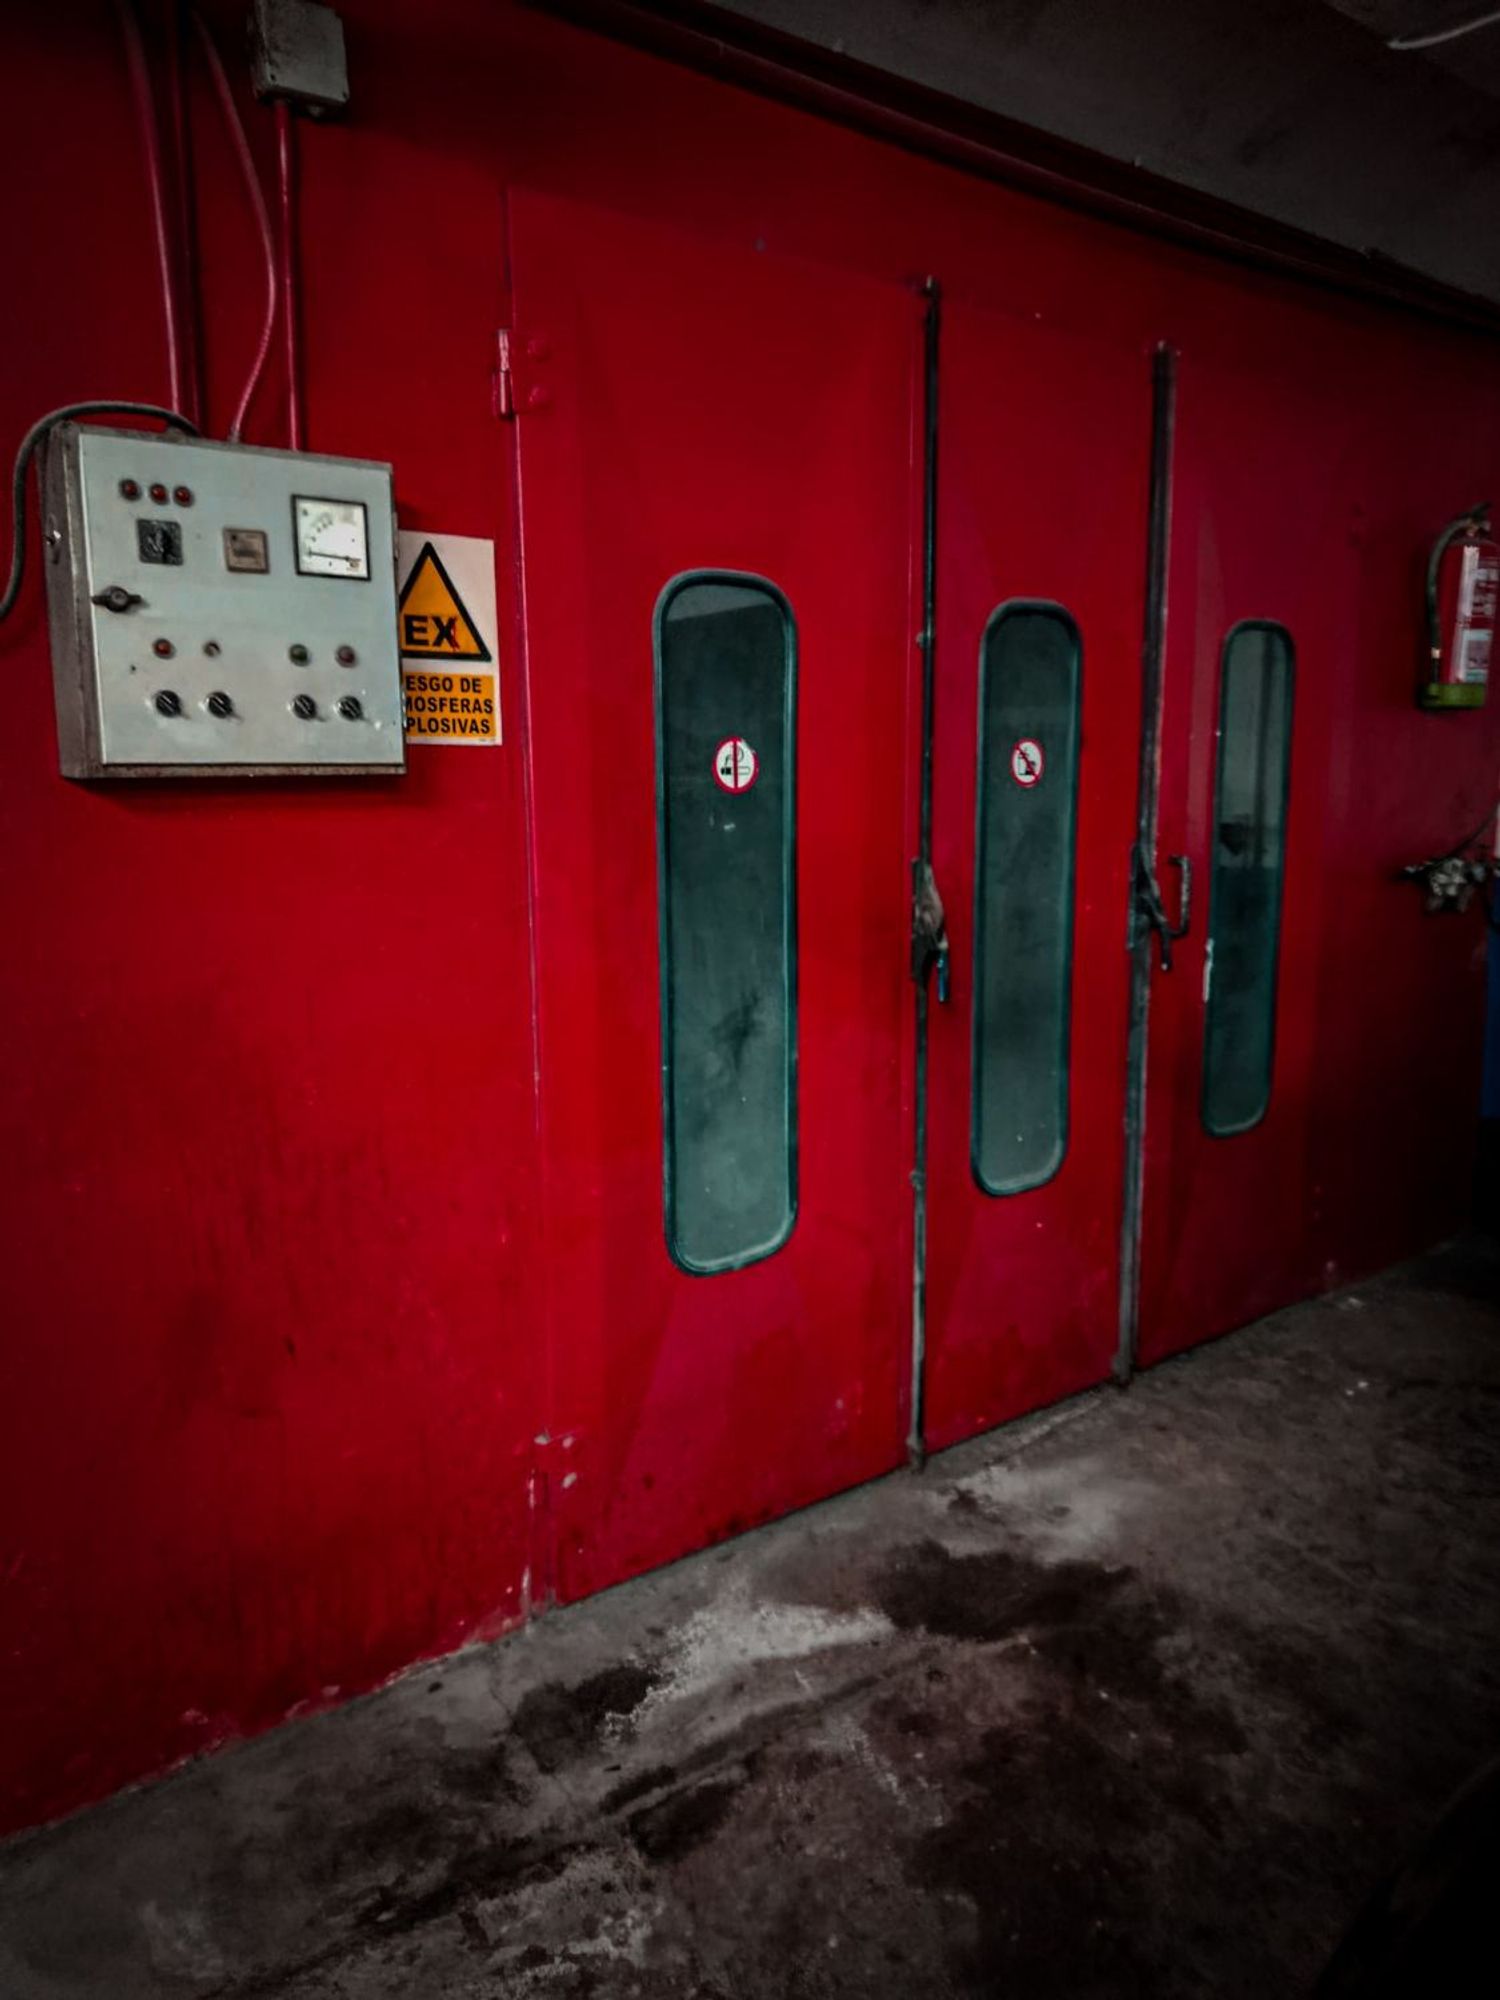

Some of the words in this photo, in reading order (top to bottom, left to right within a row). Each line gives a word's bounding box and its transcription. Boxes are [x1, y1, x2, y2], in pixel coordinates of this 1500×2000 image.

[404, 615, 460, 650] EX
[406, 676, 453, 693] ESGO
[461, 678, 482, 693] DE
[406, 717, 490, 734] PLOSIVAS
